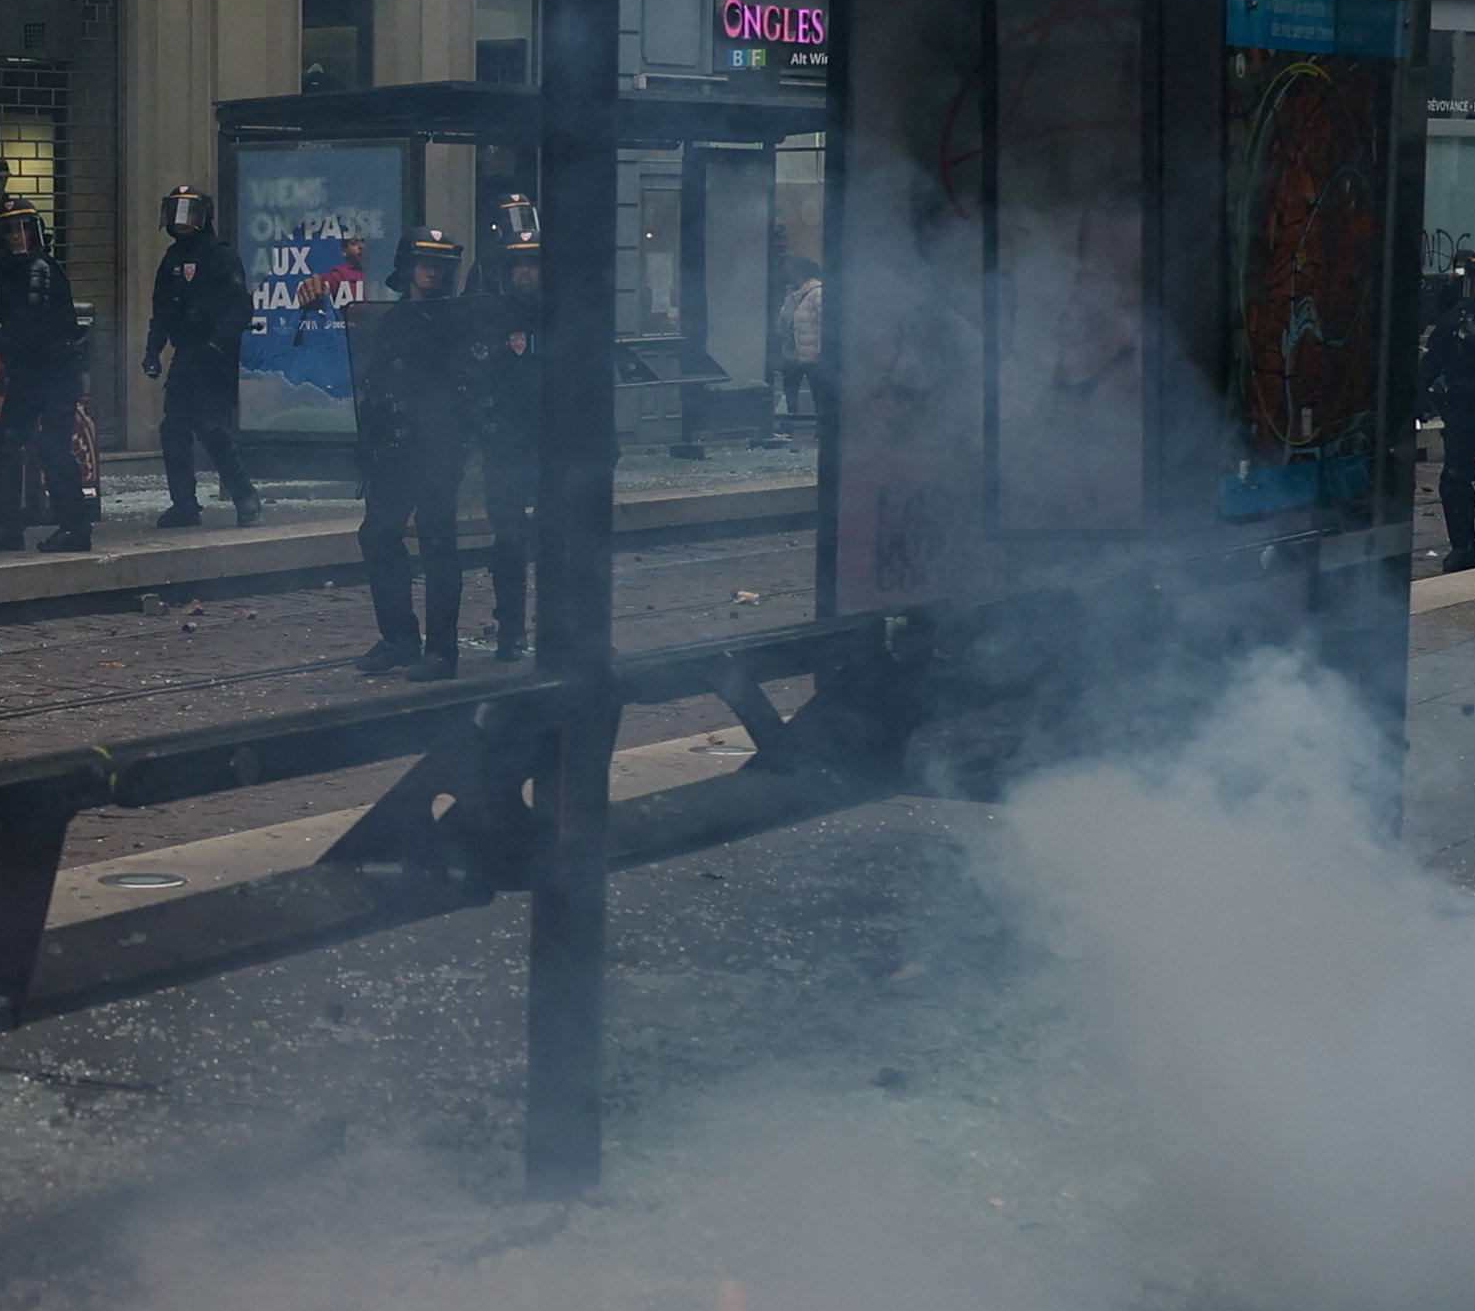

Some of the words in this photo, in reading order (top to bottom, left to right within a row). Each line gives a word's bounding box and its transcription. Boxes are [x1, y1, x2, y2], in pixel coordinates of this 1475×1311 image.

[732, 49, 744, 67] B
[751, 49, 763, 66] F
[790, 53, 808, 65] Alt
[251, 211, 295, 242] ON
[302, 208, 386, 240] PASSE
[252, 246, 312, 277] AUX
